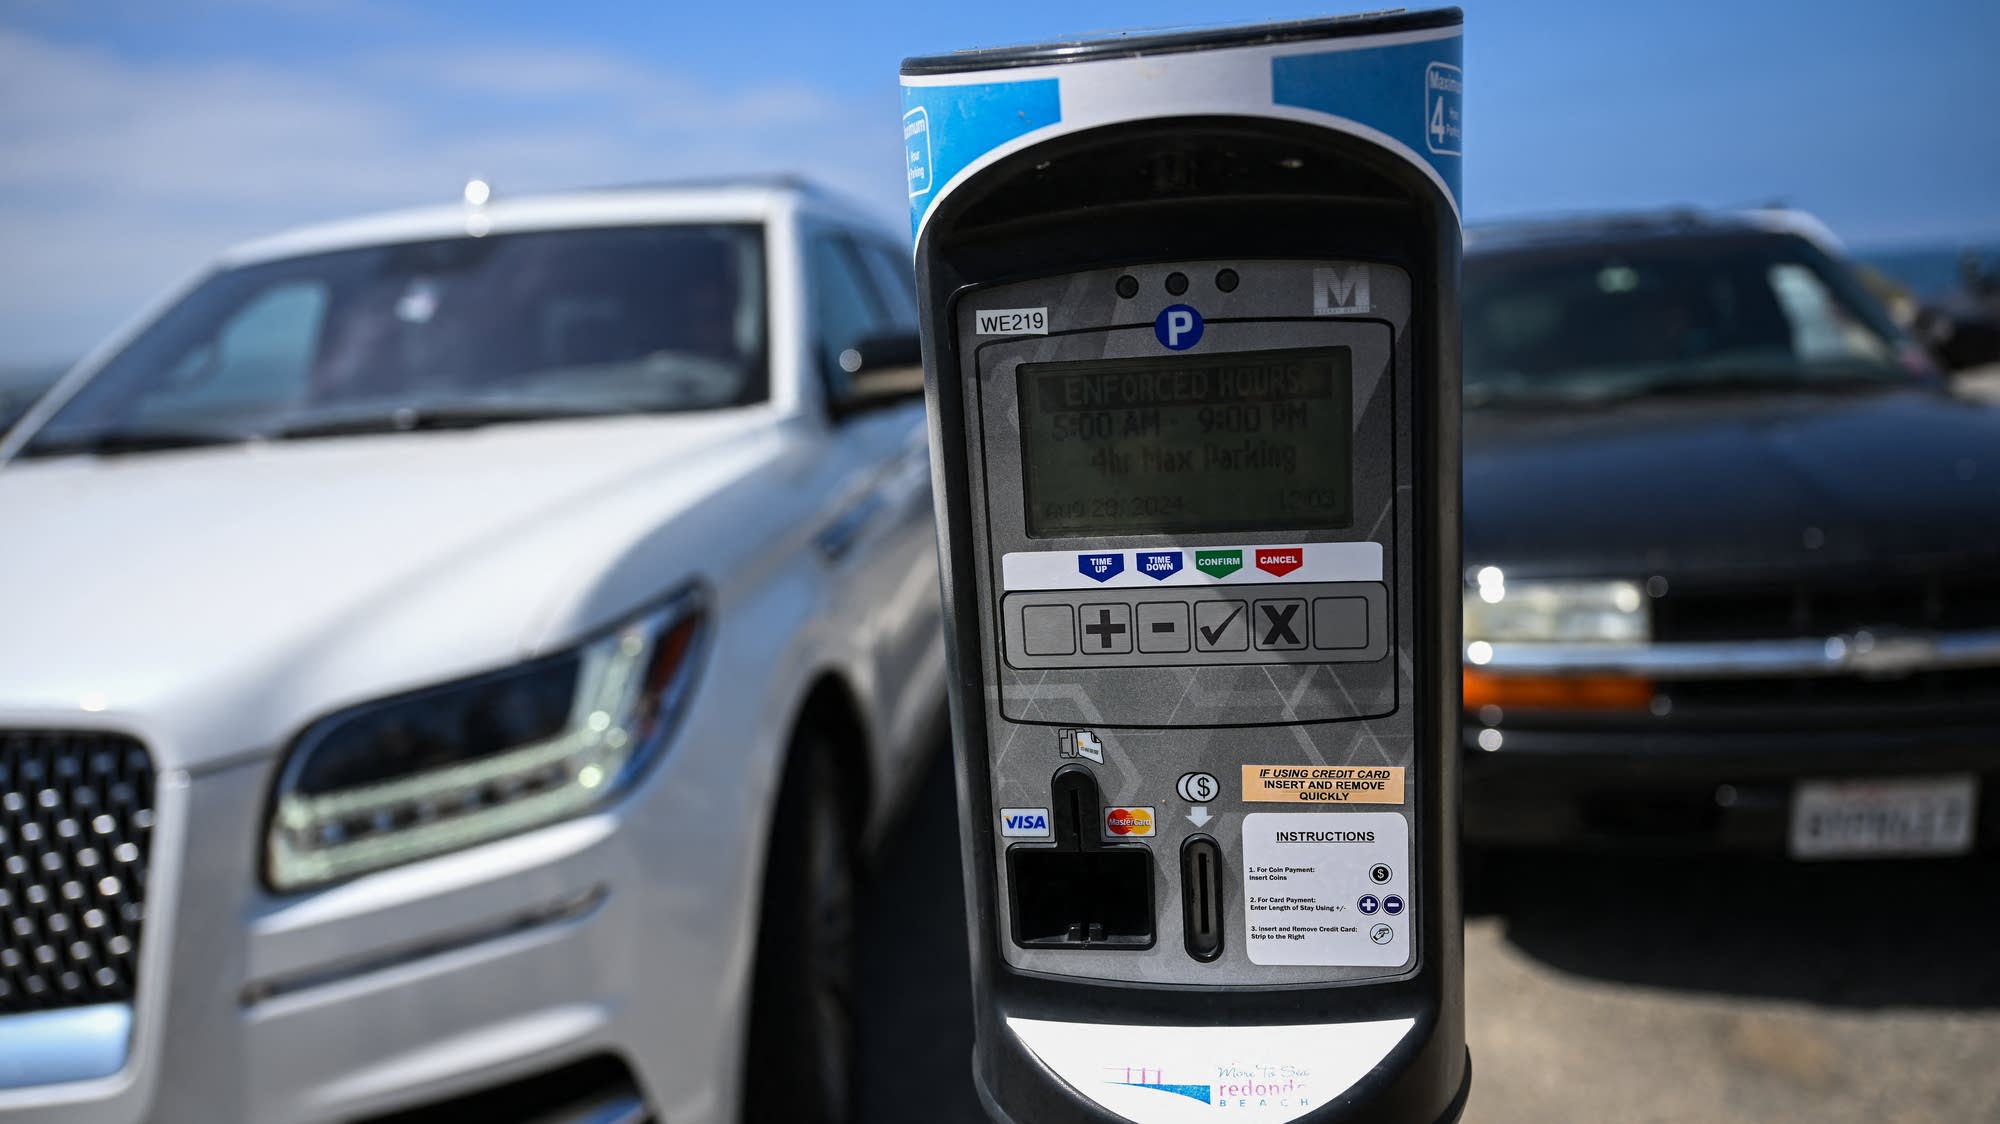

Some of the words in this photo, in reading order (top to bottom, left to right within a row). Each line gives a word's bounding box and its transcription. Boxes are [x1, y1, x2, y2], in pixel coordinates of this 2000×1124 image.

[1431, 96, 1444, 144] 4
[981, 311, 1044, 333] WE219
[1167, 310, 1193, 346] P
[1064, 371, 1209, 407] ENFORCED
[1218, 365, 1301, 398] HOURS
[1051, 411, 1114, 441] 5:00
[1122, 409, 1160, 439] AM
[1197, 404, 1261, 435] 9:00
[1271, 401, 1309, 433] PM
[1091, 445, 1130, 476] 4hr
[1142, 445, 1193, 474] Max
[1203, 439, 1297, 476] Parking
[1090, 557, 1112, 566] TIME
[1148, 556, 1171, 564] TIME
[1198, 557, 1240, 567] CONFIRM
[1260, 555, 1297, 565] CANCEL
[1095, 565, 1108, 574] UP
[1146, 563, 1174, 571] DOWN
[1259, 768, 1271, 778] IF
[1273, 769, 1309, 778] USING
[1312, 769, 1355, 779] CREDIT
[1357, 770, 1391, 779] CARD
[1264, 780, 1305, 790] INSERT
[1308, 780, 1333, 790] AND
[1335, 781, 1385, 791] REMOVE
[1299, 791, 1350, 801] QUICKLY
[1005, 815, 1047, 829] VISA
[1109, 818, 1152, 828] MasterCard
[1276, 831, 1376, 843] INSTRUCTIONS
[1285, 866, 1315, 874] Payment:
